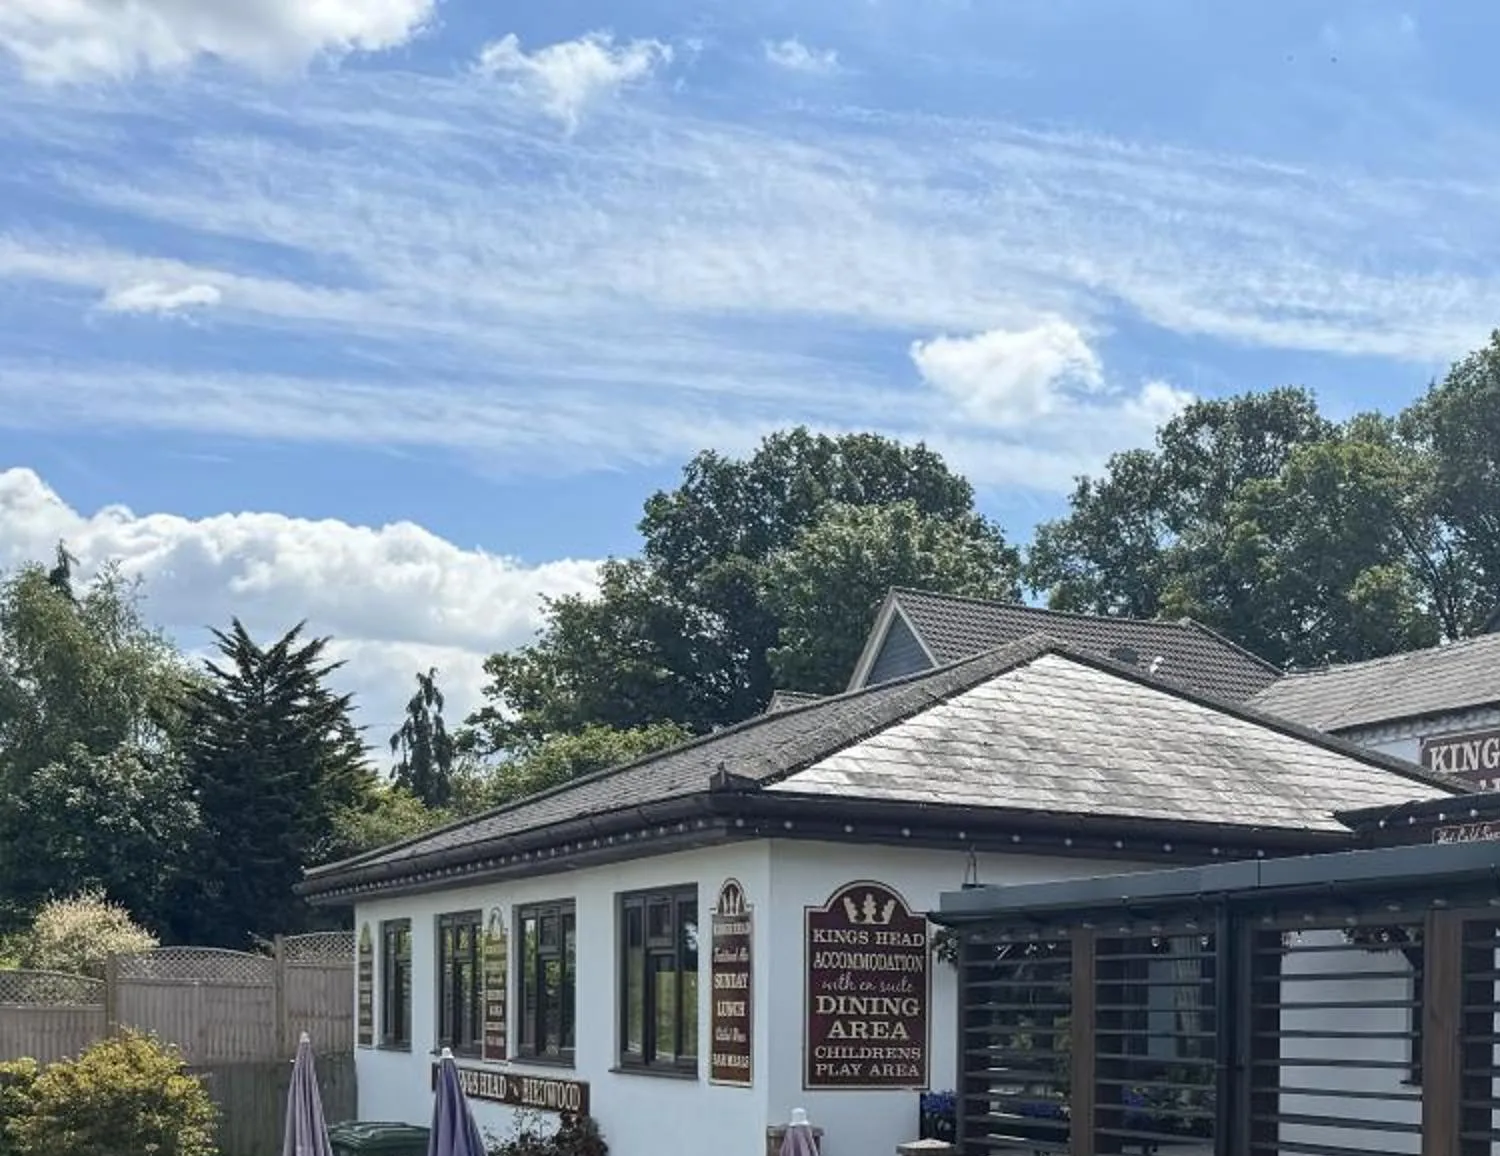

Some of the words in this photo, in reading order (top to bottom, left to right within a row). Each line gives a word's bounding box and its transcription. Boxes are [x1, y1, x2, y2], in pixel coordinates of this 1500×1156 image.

[813, 929, 869, 945] KINGS
[875, 931, 925, 947] HEAD
[813, 951, 924, 972] ACCOMMODATION
[816, 995, 920, 1016] DINING
[828, 1020, 910, 1040] AREA
[814, 1045, 921, 1060] CHILDRENS
[816, 1063, 863, 1077] PLAY
[869, 1064, 920, 1077] AREA
